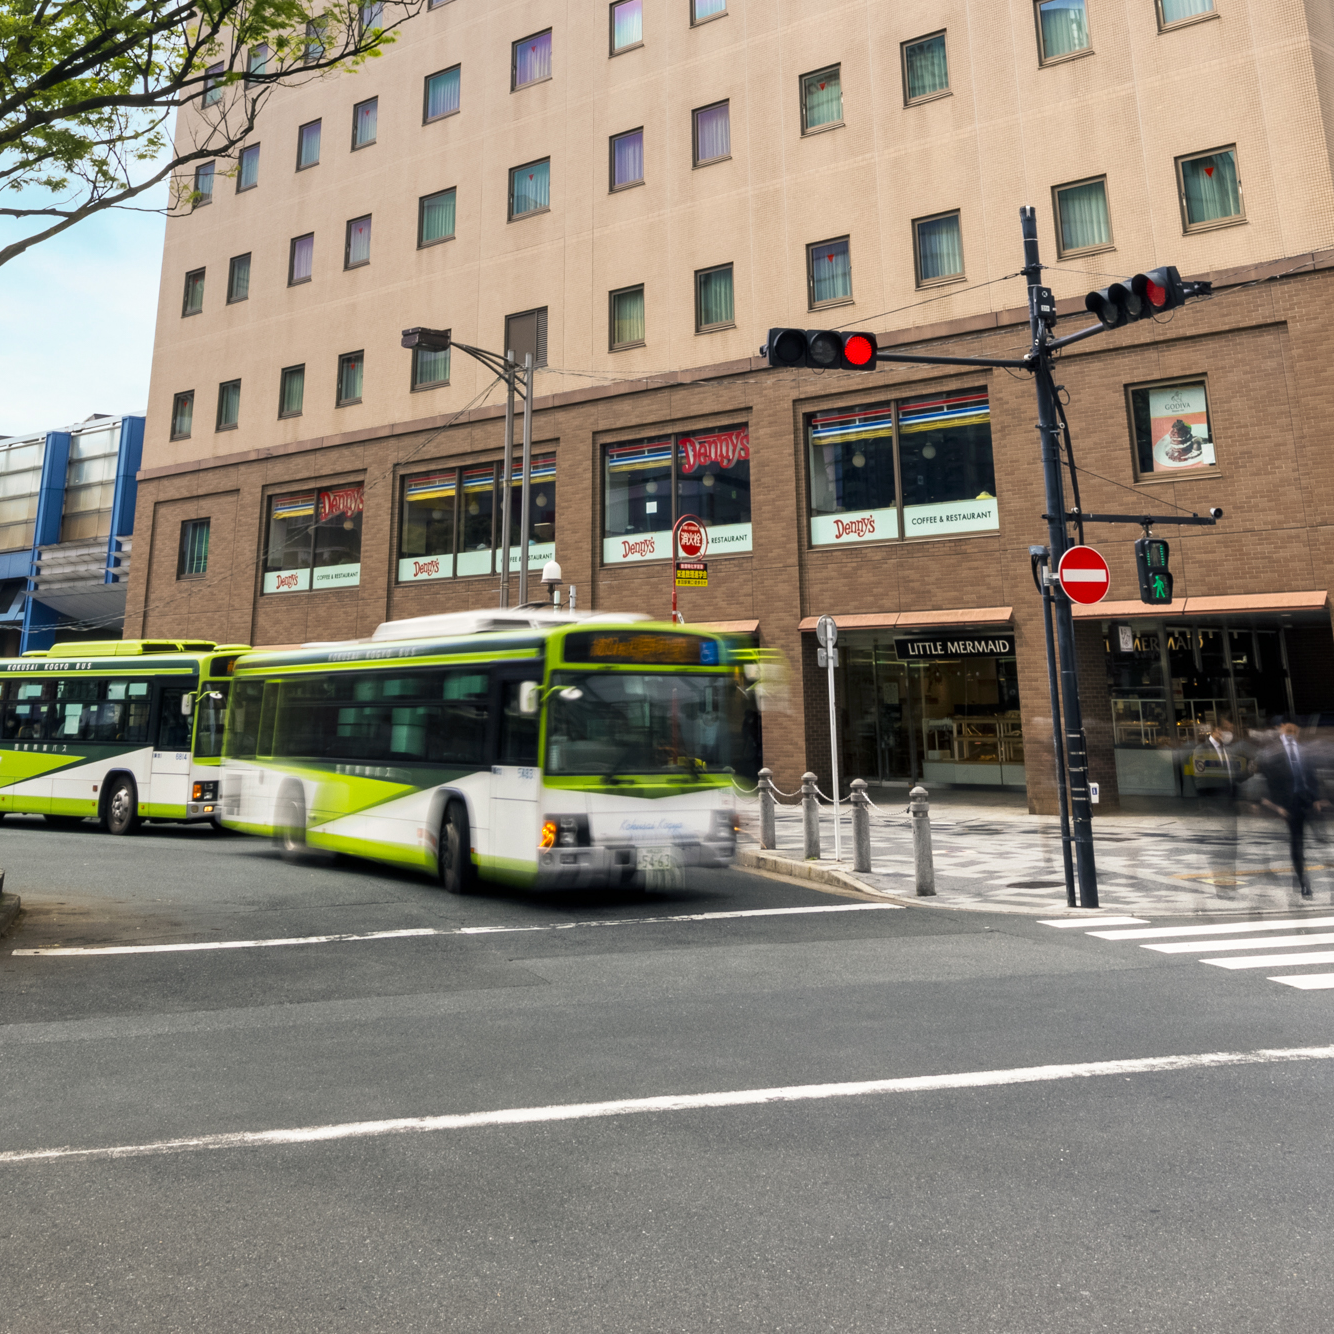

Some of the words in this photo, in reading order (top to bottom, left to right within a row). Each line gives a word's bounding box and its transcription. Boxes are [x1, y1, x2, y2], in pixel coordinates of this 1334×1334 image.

[1164, 402, 1191, 410] GODIVA
[678, 426, 750, 474] Denny's
[911, 516, 937, 525] COFFEE
[939, 515, 944, 523] &
[945, 511, 991, 522] RESTAURANT
[833, 515, 875, 539] Denny's
[681, 532, 701, 546] 消火栓
[711, 534, 748, 544] RESTAURANT
[622, 537, 655, 558] Denny's
[413, 558, 439, 577] Denny's
[276, 572, 298, 589] Denny's
[334, 571, 358, 579] RESTAURANT
[908, 642, 945, 655] LITTLE
[947, 640, 1009, 654] MERMAID
[7, 663, 38, 671] KOKUSAI
